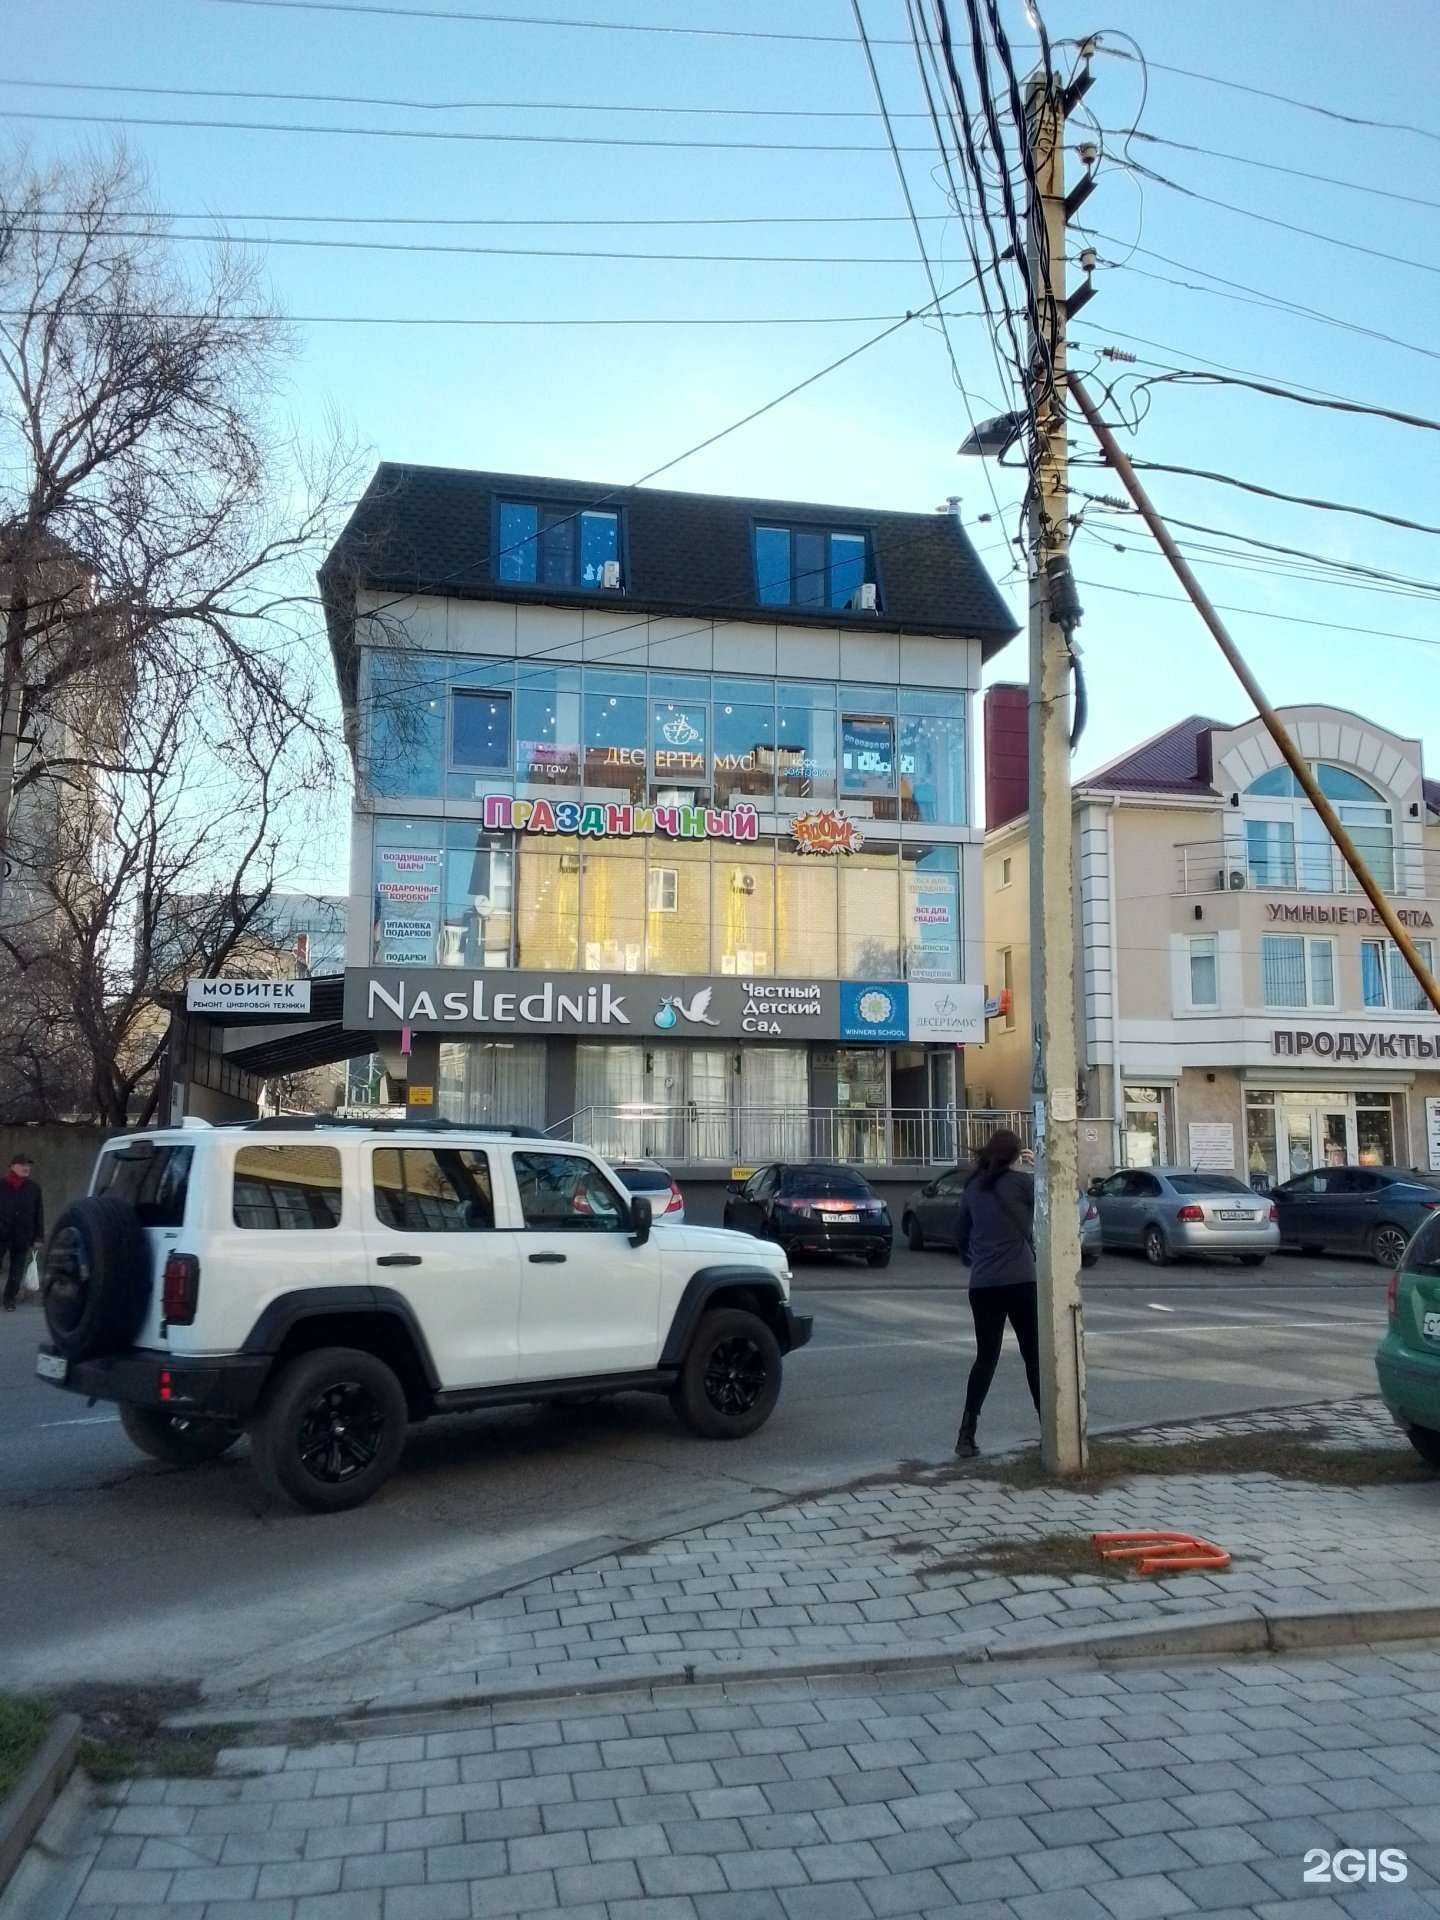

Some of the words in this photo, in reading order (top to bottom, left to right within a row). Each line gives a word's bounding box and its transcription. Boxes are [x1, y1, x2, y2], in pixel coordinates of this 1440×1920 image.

[1267, 903, 1350, 923] УМНЫЕ
[1356, 907, 1434, 928] РЕЯТА
[386, 921, 431, 930] УПАКОВКА
[385, 929, 431, 938] ПОДАРКОВ
[386, 953, 427, 962] ПОДАРКИ
[203, 983, 295, 997] МОБИТЕК
[742, 982, 821, 999] Частный
[193, 1001, 222, 1009] РЕМОНТ
[226, 1001, 271, 1010] ЦИФРОВОЙ
[742, 999, 821, 1016] Детский
[742, 1017, 782, 1035] Сад
